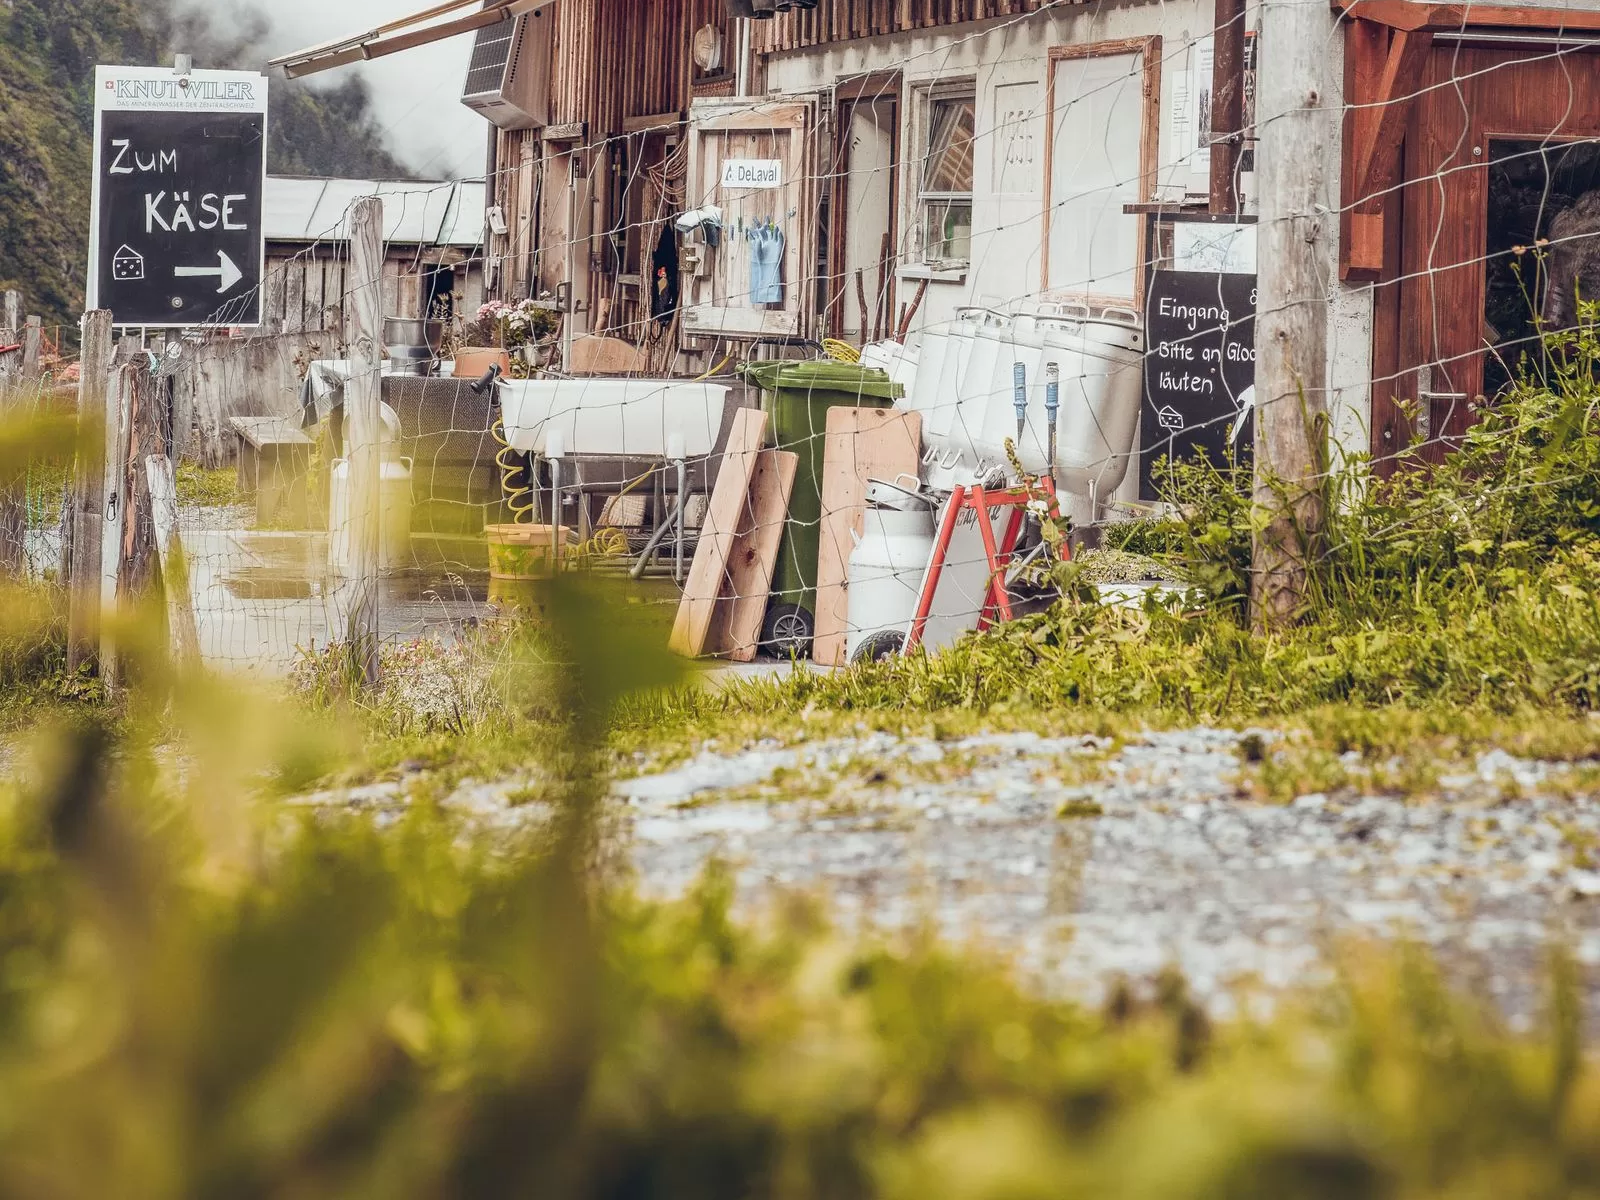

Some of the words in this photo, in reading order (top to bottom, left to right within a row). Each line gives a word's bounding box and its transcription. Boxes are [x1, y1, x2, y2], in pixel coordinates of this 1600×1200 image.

[116, 79, 255, 100] KNUTWILER
[738, 165, 777, 182] DeLaval
[145, 190, 248, 233] KÄSE
[1159, 297, 1230, 333] Eingang
[1159, 341, 1195, 361] Bitte
[1202, 348, 1221, 362] an
[1159, 371, 1213, 394] läuten
